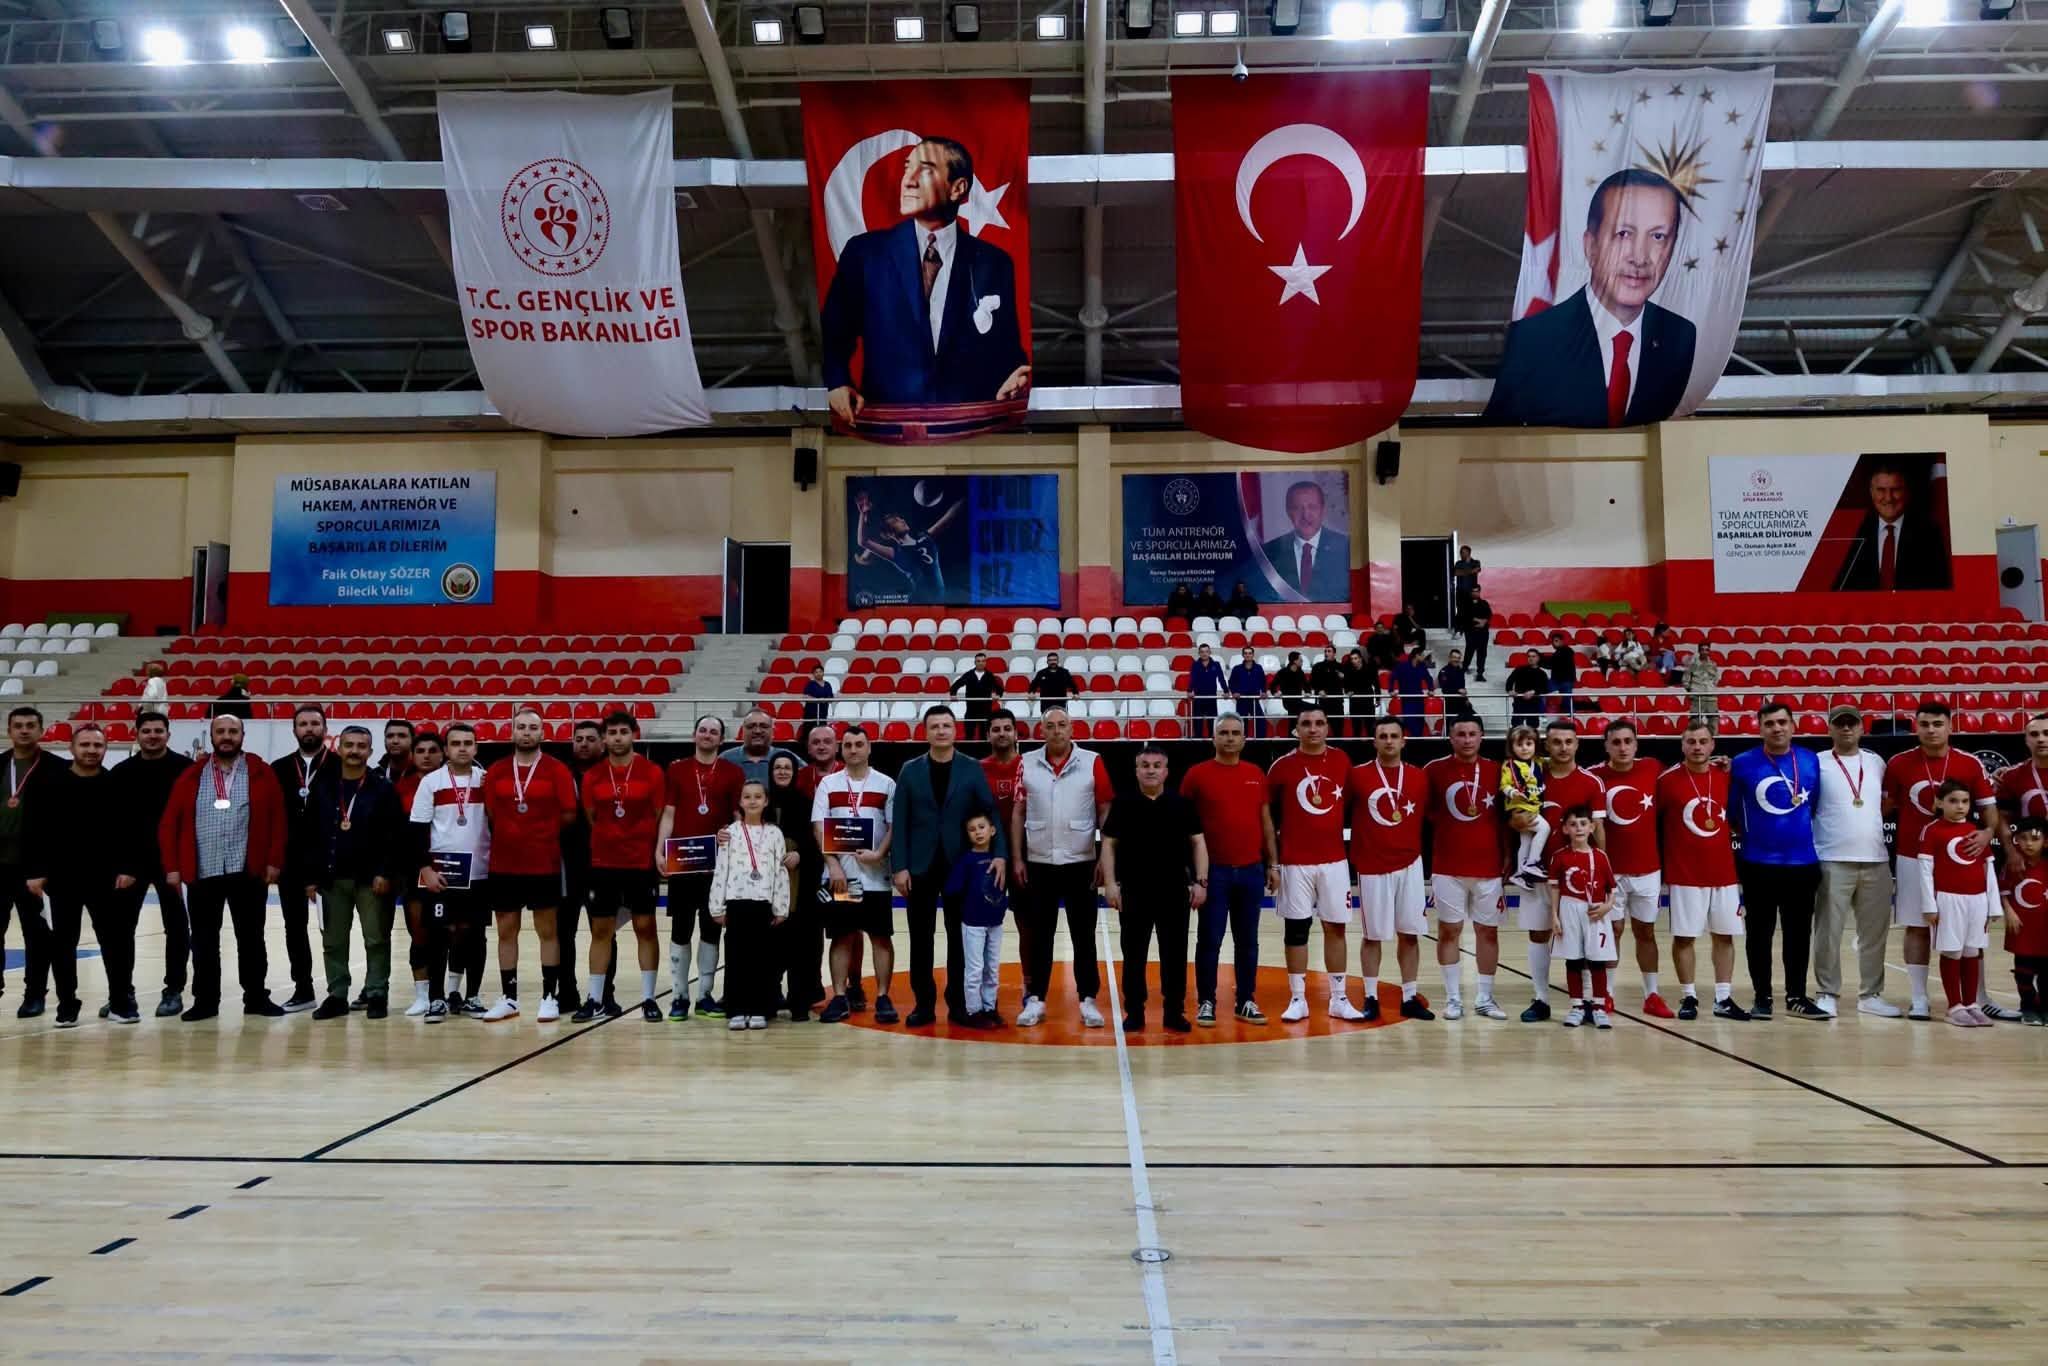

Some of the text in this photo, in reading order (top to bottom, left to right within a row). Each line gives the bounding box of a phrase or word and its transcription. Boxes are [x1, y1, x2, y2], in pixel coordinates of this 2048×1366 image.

[466, 287, 675, 316] T.C. GENÇLİK VE
[471, 315, 680, 343] SPOR BAKANLIĞI
[291, 477, 470, 491] MÜSABAKALARA KATILAN
[302, 496, 457, 513] HAKEM, ANTRENÖR VE
[1743, 509, 1796, 519] ANTRENÖR
[1797, 510, 1809, 519] VE
[317, 520, 440, 533] SPORCULARIMIZA
[1722, 520, 1806, 529] SPORCULARIMIZA
[1168, 526, 1225, 537] ANTRENÖR
[1717, 529, 1812, 540] BAŞARILAR DİLİYORUM
[309, 538, 447, 554] BAŞARILAR DİLERİM
[1130, 540, 1237, 551] VE SPORCULARIMIZA
[1132, 551, 1233, 563] BAŞARILAR DİLİYORUM
[322, 566, 430, 582] Faik Oktay SÖZER
[338, 584, 413, 597] Bilecik Valisi
[434, 903, 444, 918] 8
[1599, 932, 1606, 948] 7
